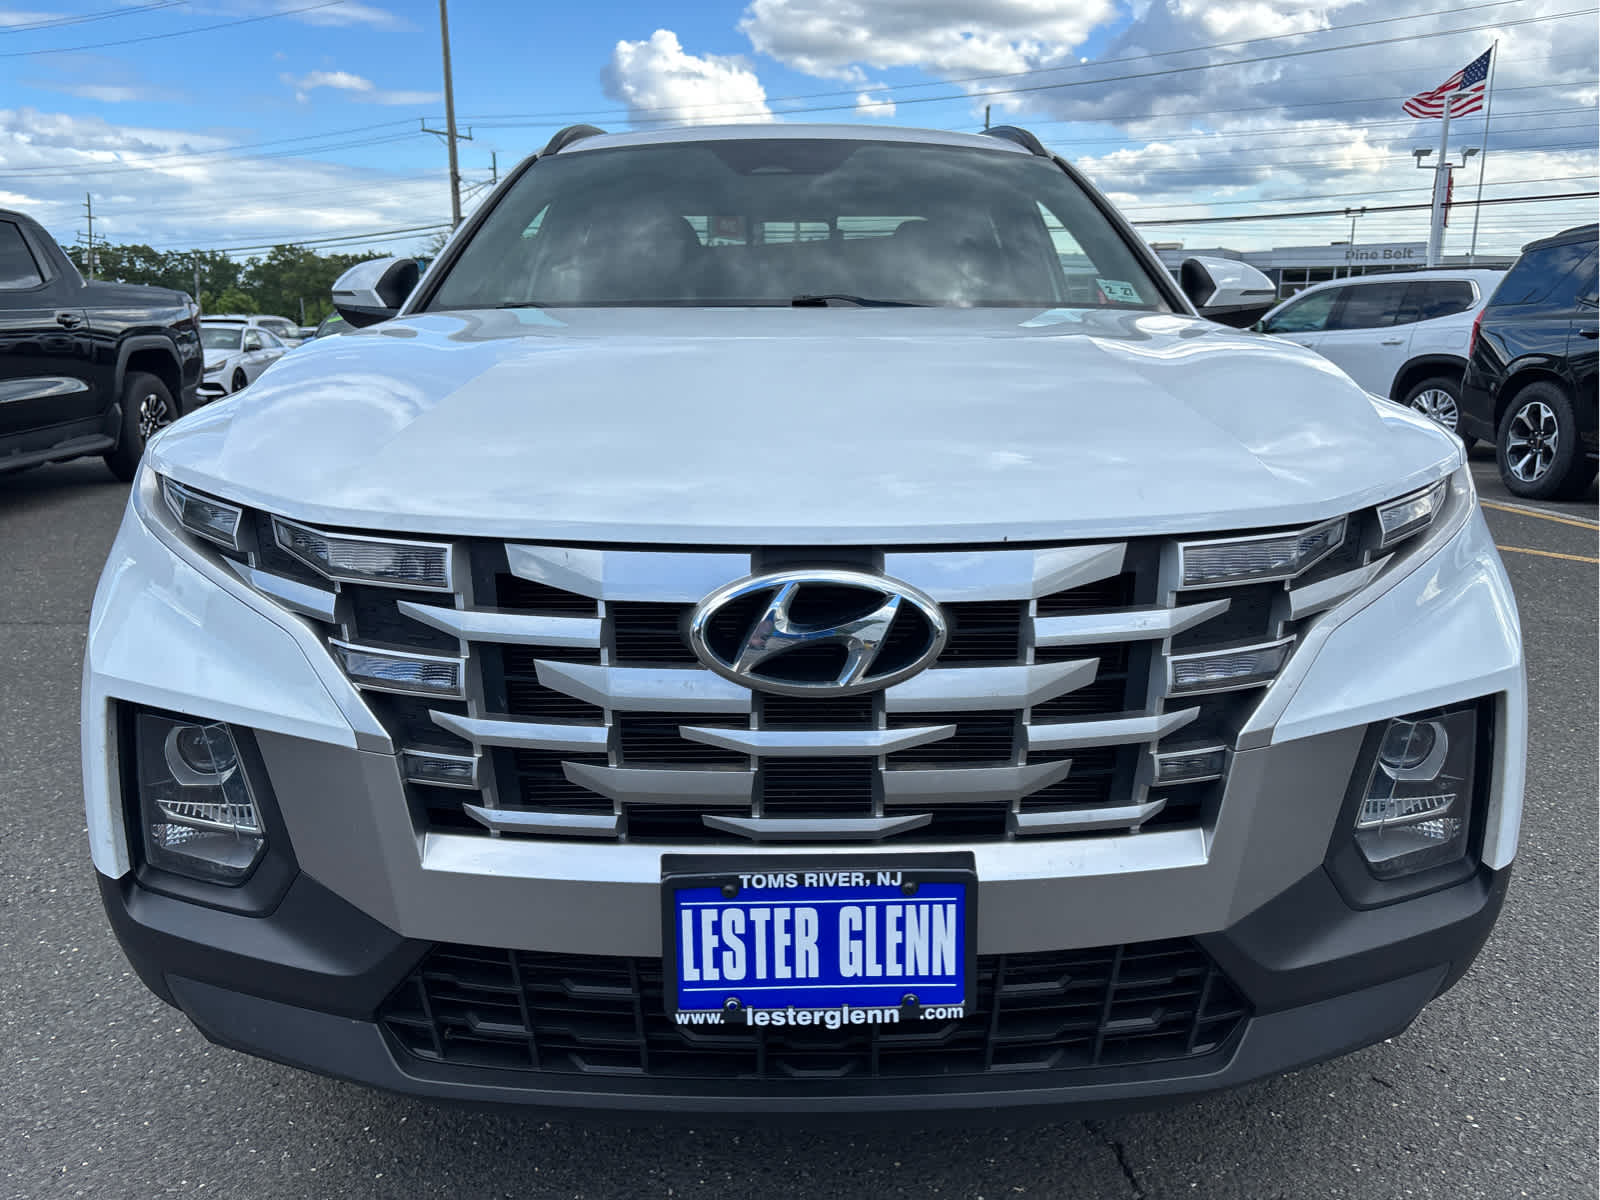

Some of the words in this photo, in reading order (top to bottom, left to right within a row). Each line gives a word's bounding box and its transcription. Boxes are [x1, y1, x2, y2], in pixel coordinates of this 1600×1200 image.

[1345, 249, 1378, 261] Pine
[1383, 248, 1414, 260] Belt
[739, 874, 798, 889] TOMS
[804, 872, 871, 887] RIVER,
[877, 871, 902, 886] NJ
[681, 907, 819, 982] LESTER
[838, 903, 957, 978] GLENN
[675, 1012, 725, 1025] www.
[746, 1006, 900, 1030] lesterglenn
[919, 1005, 964, 1020] .com
